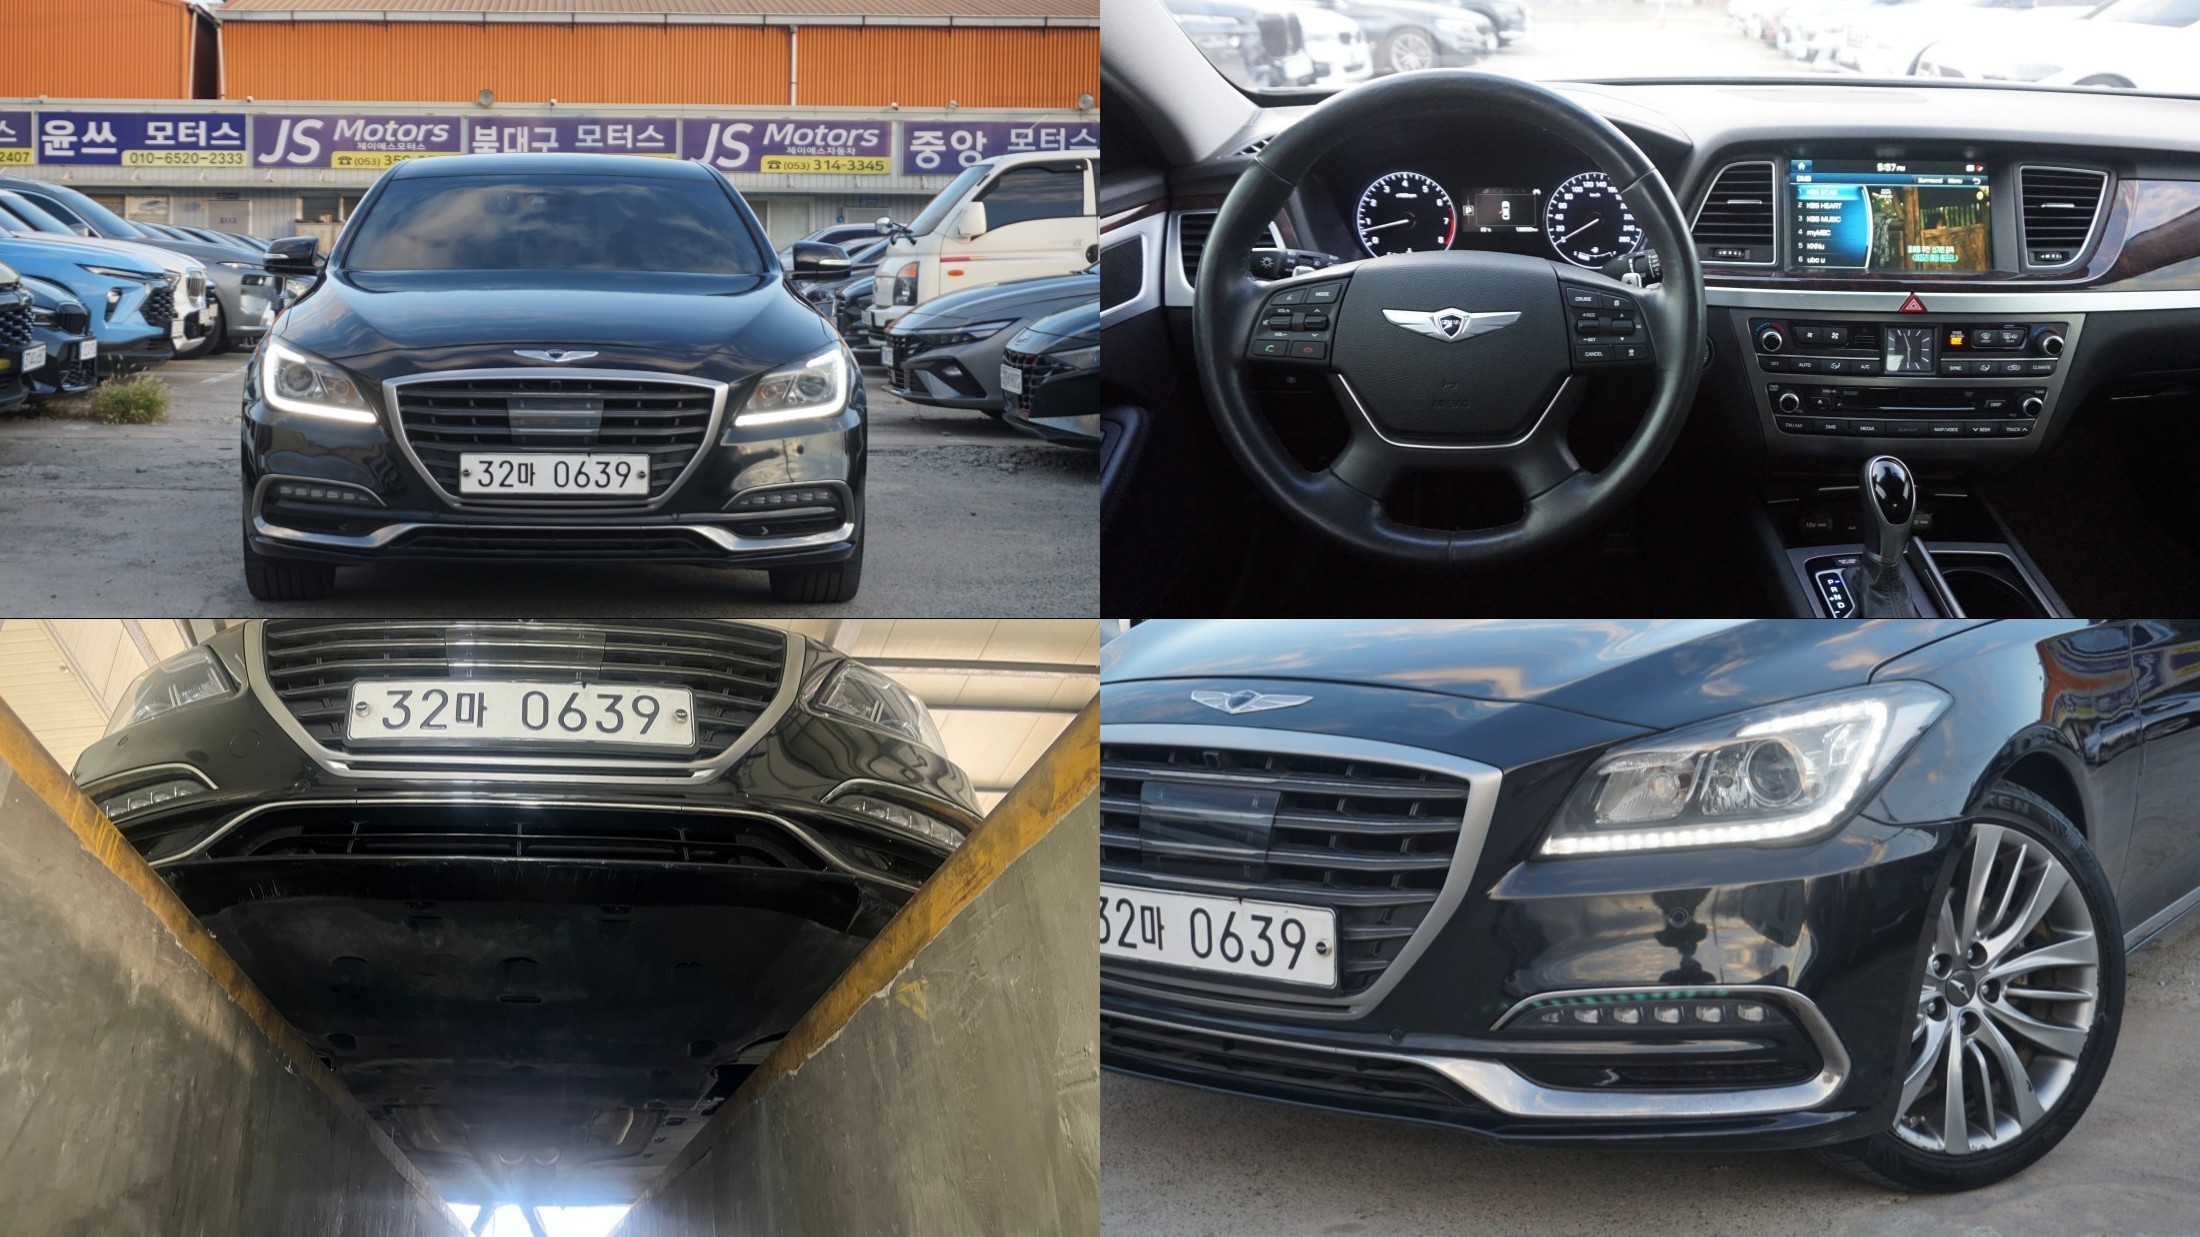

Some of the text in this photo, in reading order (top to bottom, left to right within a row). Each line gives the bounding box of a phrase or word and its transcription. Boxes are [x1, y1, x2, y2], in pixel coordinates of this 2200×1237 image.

[41, 119, 241, 156] 윤쓰 모터스
[333, 118, 450, 142] Motors
[472, 124, 665, 153] 북대구 모터스
[763, 123, 880, 147] Motors
[257, 118, 324, 164] JS
[690, 122, 754, 168] JS
[910, 128, 1098, 169] 중앙 모터스
[130, 152, 243, 165] 010-6520-2333
[786, 146, 856, 156] 제이에스자동차
[354, 155, 381, 167] (053)
[783, 158, 885, 172] (053) 314-3345
[1383, 185, 1390, 193] 3
[1422, 185, 1429, 193] 5
[1370, 199, 1377, 207] 2
[1365, 217, 1371, 225] 1
[1443, 217, 1449, 225] 7
[478, 460, 631, 488] 32마 0639
[1837, 601, 1845, 609] D
[382, 689, 661, 735] 32마 0639
[1189, 907, 1306, 970] 0639
